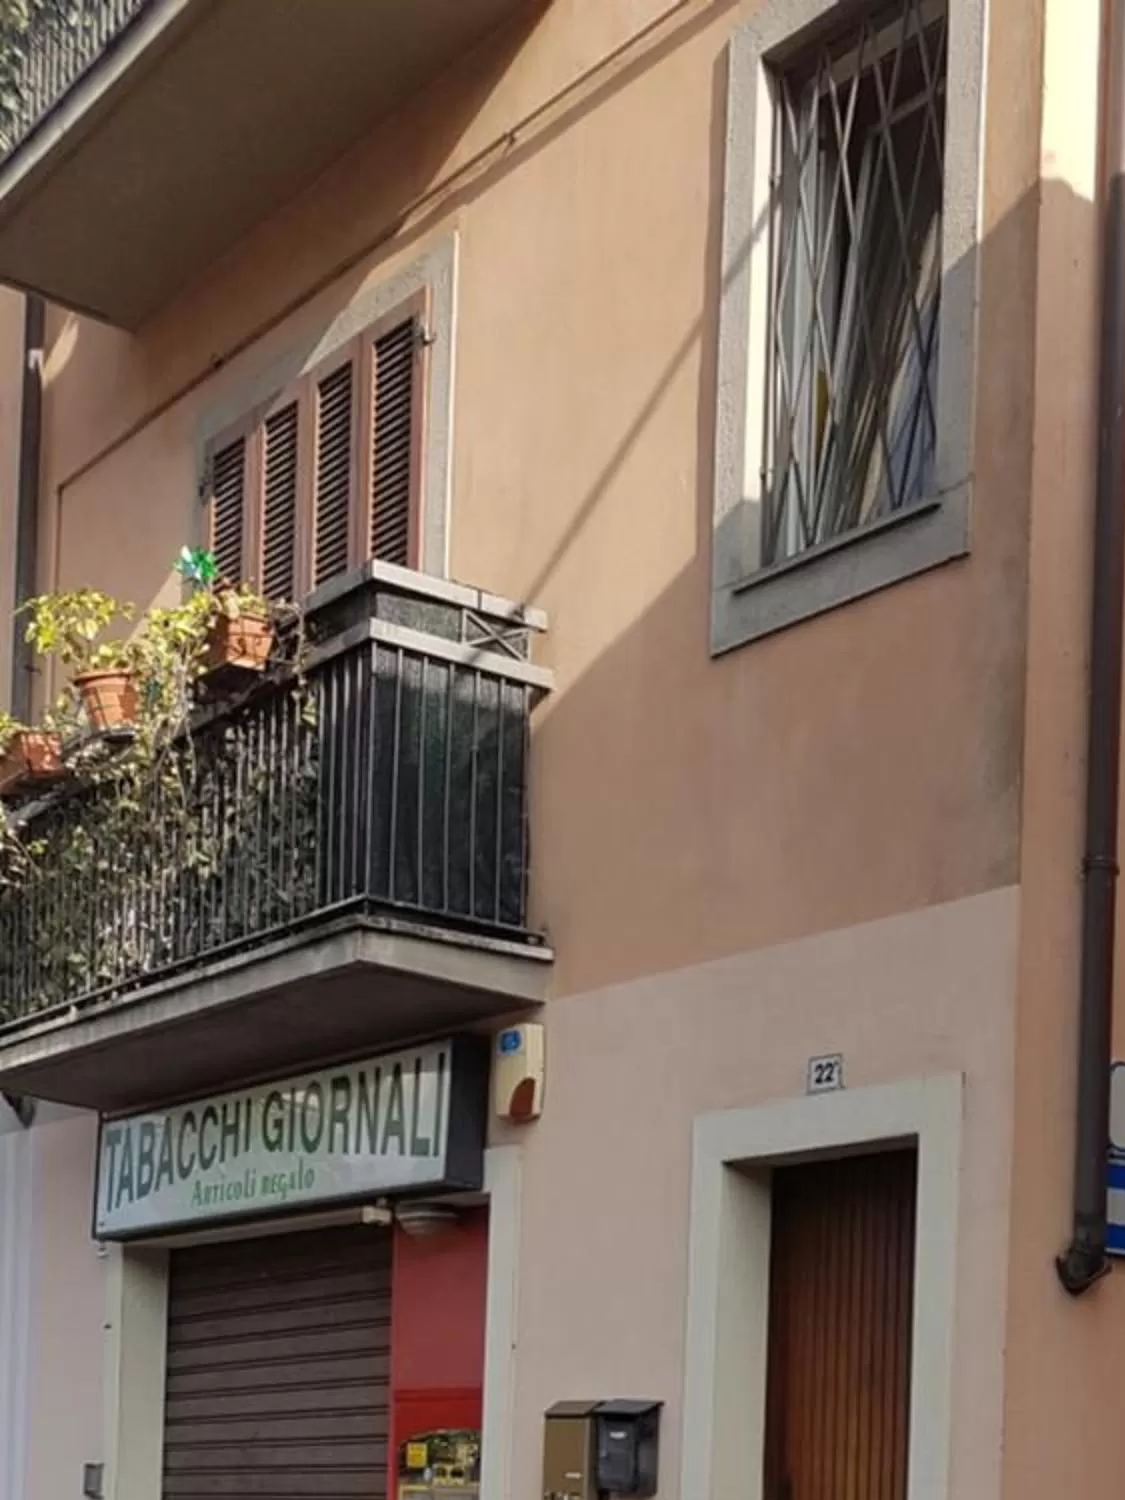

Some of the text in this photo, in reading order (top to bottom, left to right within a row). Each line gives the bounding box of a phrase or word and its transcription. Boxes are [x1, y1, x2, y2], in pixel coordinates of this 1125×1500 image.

[814, 1061, 835, 1084] 22
[106, 1052, 446, 1213] TABACCHI GIORNALI
